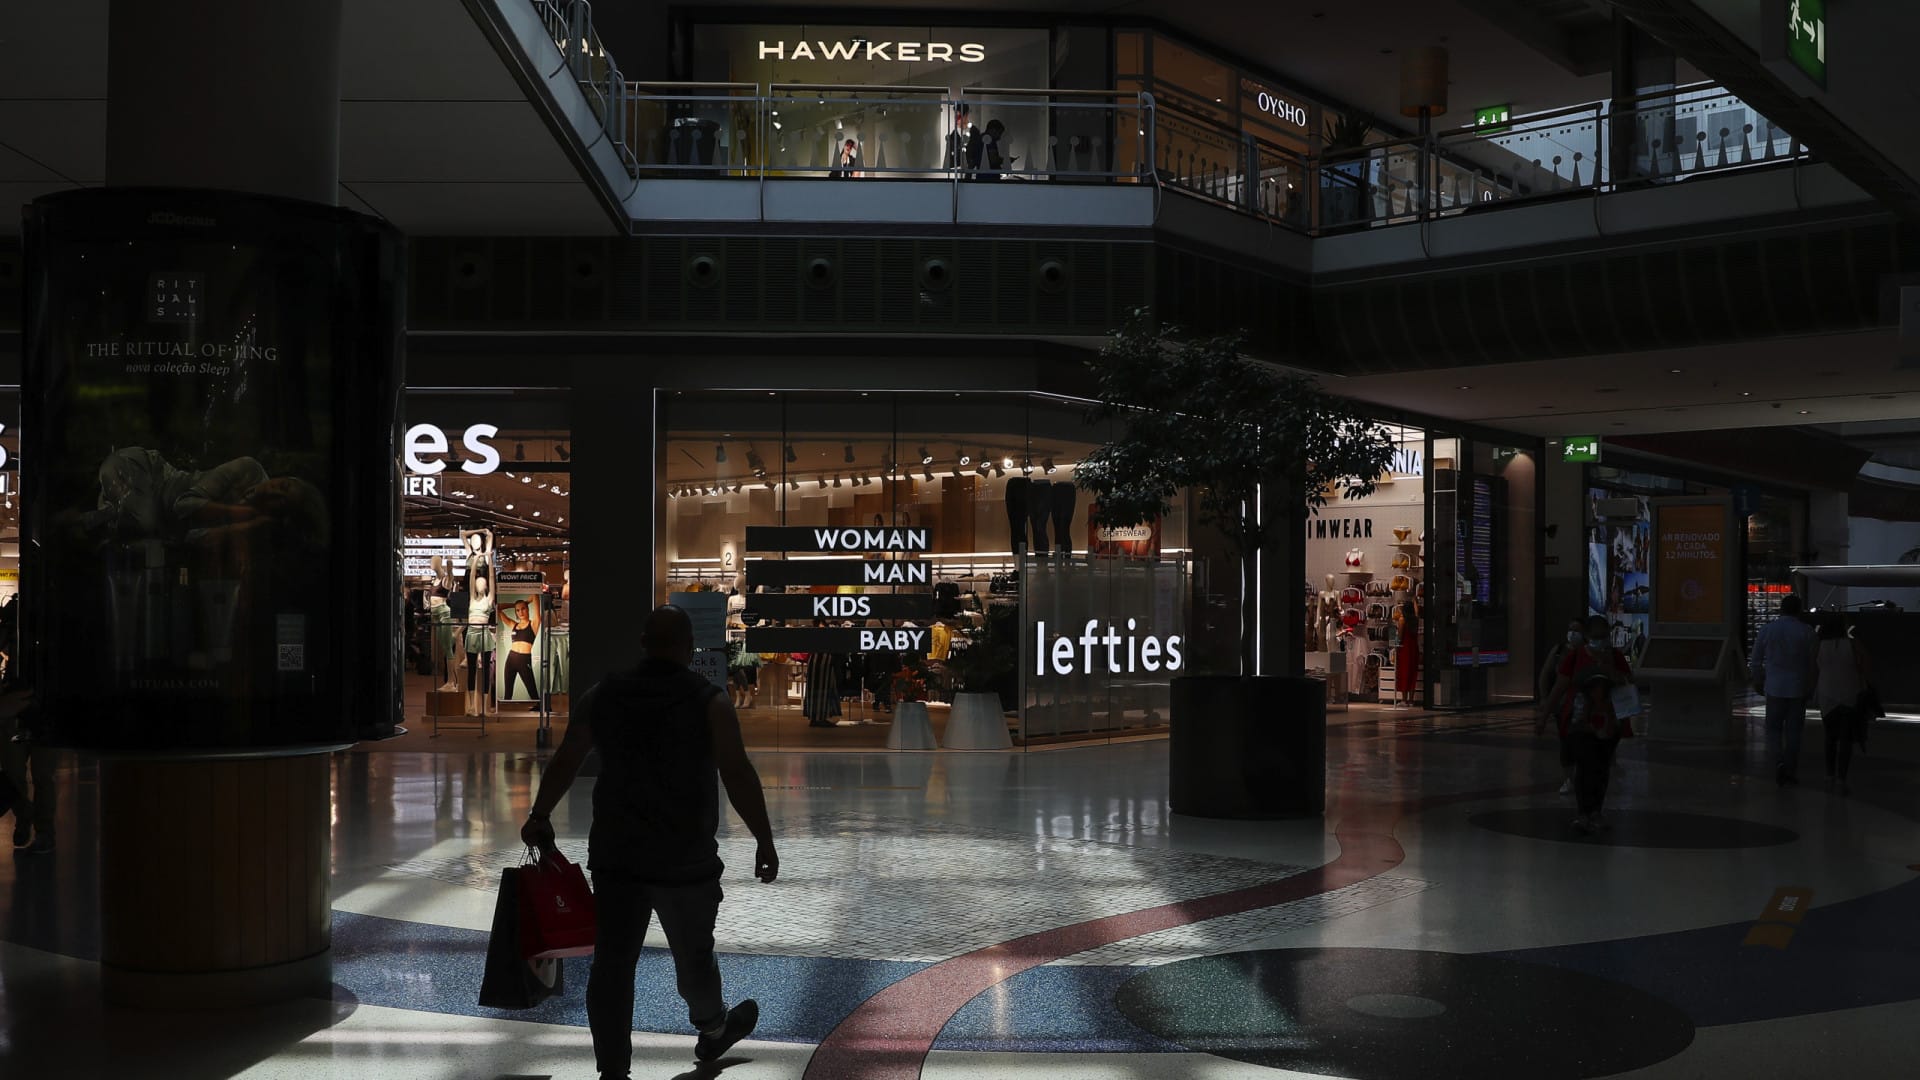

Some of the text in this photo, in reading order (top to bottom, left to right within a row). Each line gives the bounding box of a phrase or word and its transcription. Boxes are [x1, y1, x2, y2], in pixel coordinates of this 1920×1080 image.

[758, 40, 985, 63] HAWKERS
[1258, 92, 1306, 127] OYSHO
[87, 343, 120, 357] THE
[126, 361, 231, 377] nova coleção Sleep
[814, 529, 926, 550] WOMAN
[1103, 529, 1147, 538] SPORTSWEAR
[725, 551, 732, 566] 2
[864, 562, 926, 583] MAN
[813, 596, 871, 616] KIDS
[860, 630, 925, 651] BABY
[1036, 617, 1182, 676] lefties
